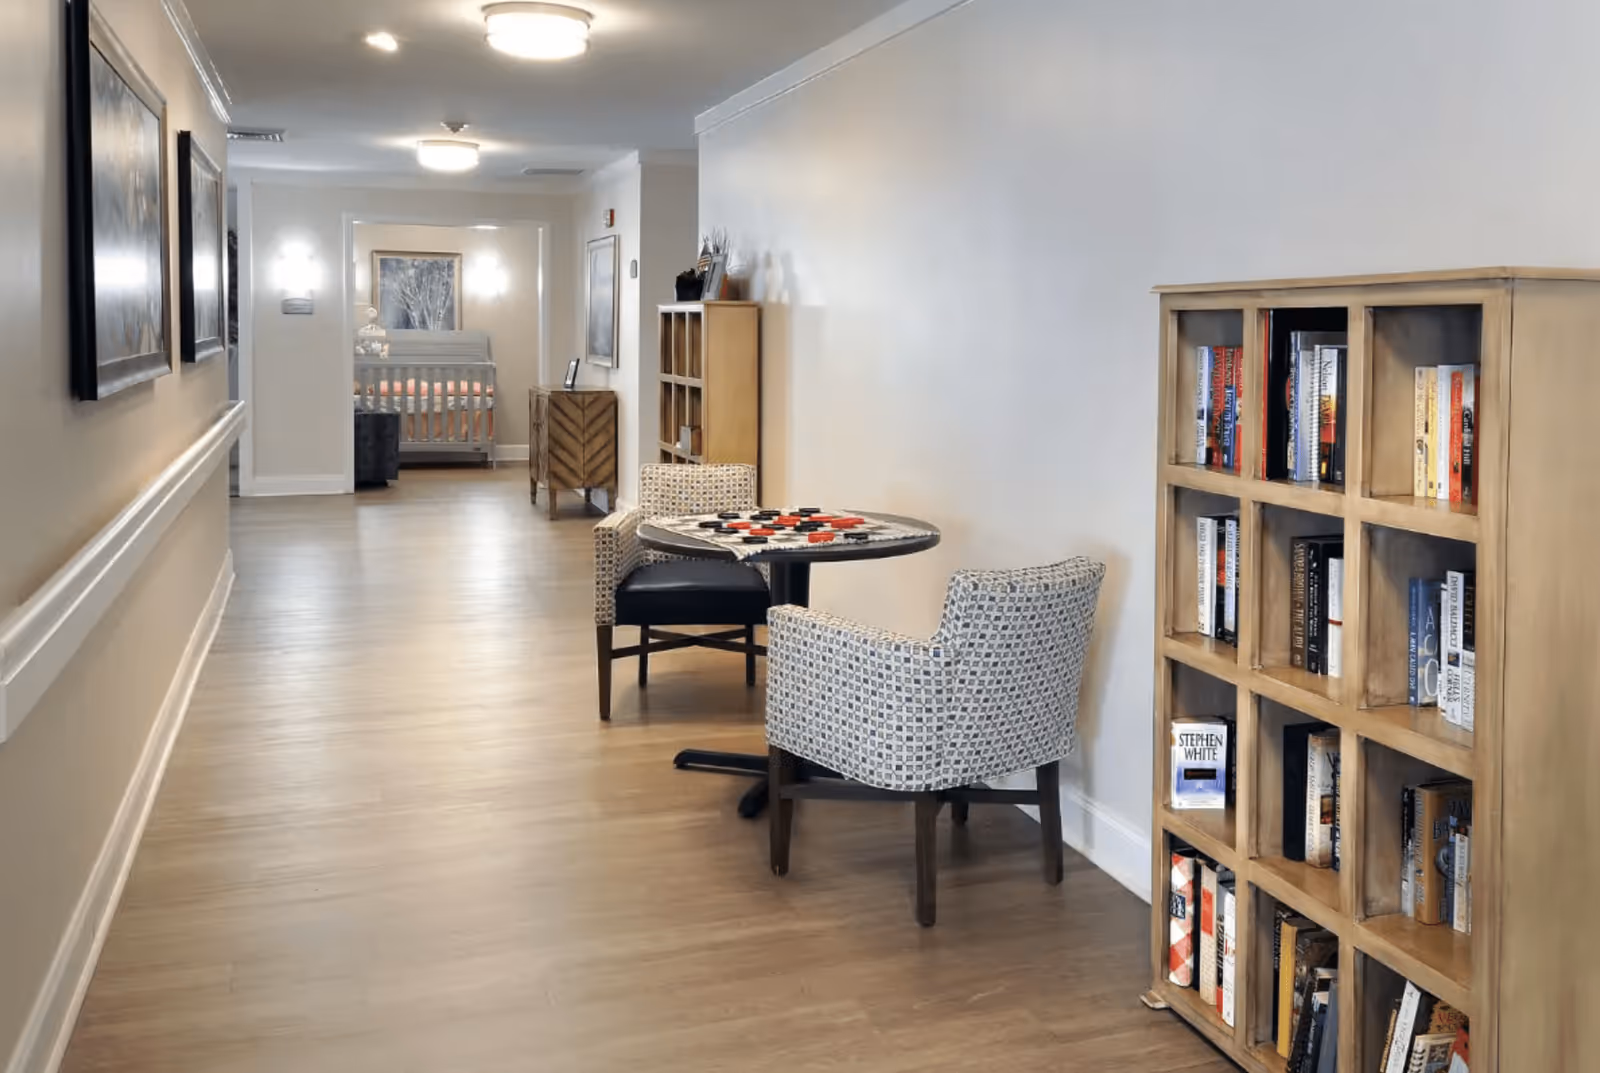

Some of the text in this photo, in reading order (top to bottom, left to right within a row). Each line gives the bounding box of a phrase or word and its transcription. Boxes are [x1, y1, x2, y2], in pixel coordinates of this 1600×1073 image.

[1322, 360, 1333, 391] Nelson
[1449, 575, 1459, 648] DAVID BALDACCI
[1179, 733, 1223, 747] STEPHEN
[1184, 748, 1217, 761] WHITE
